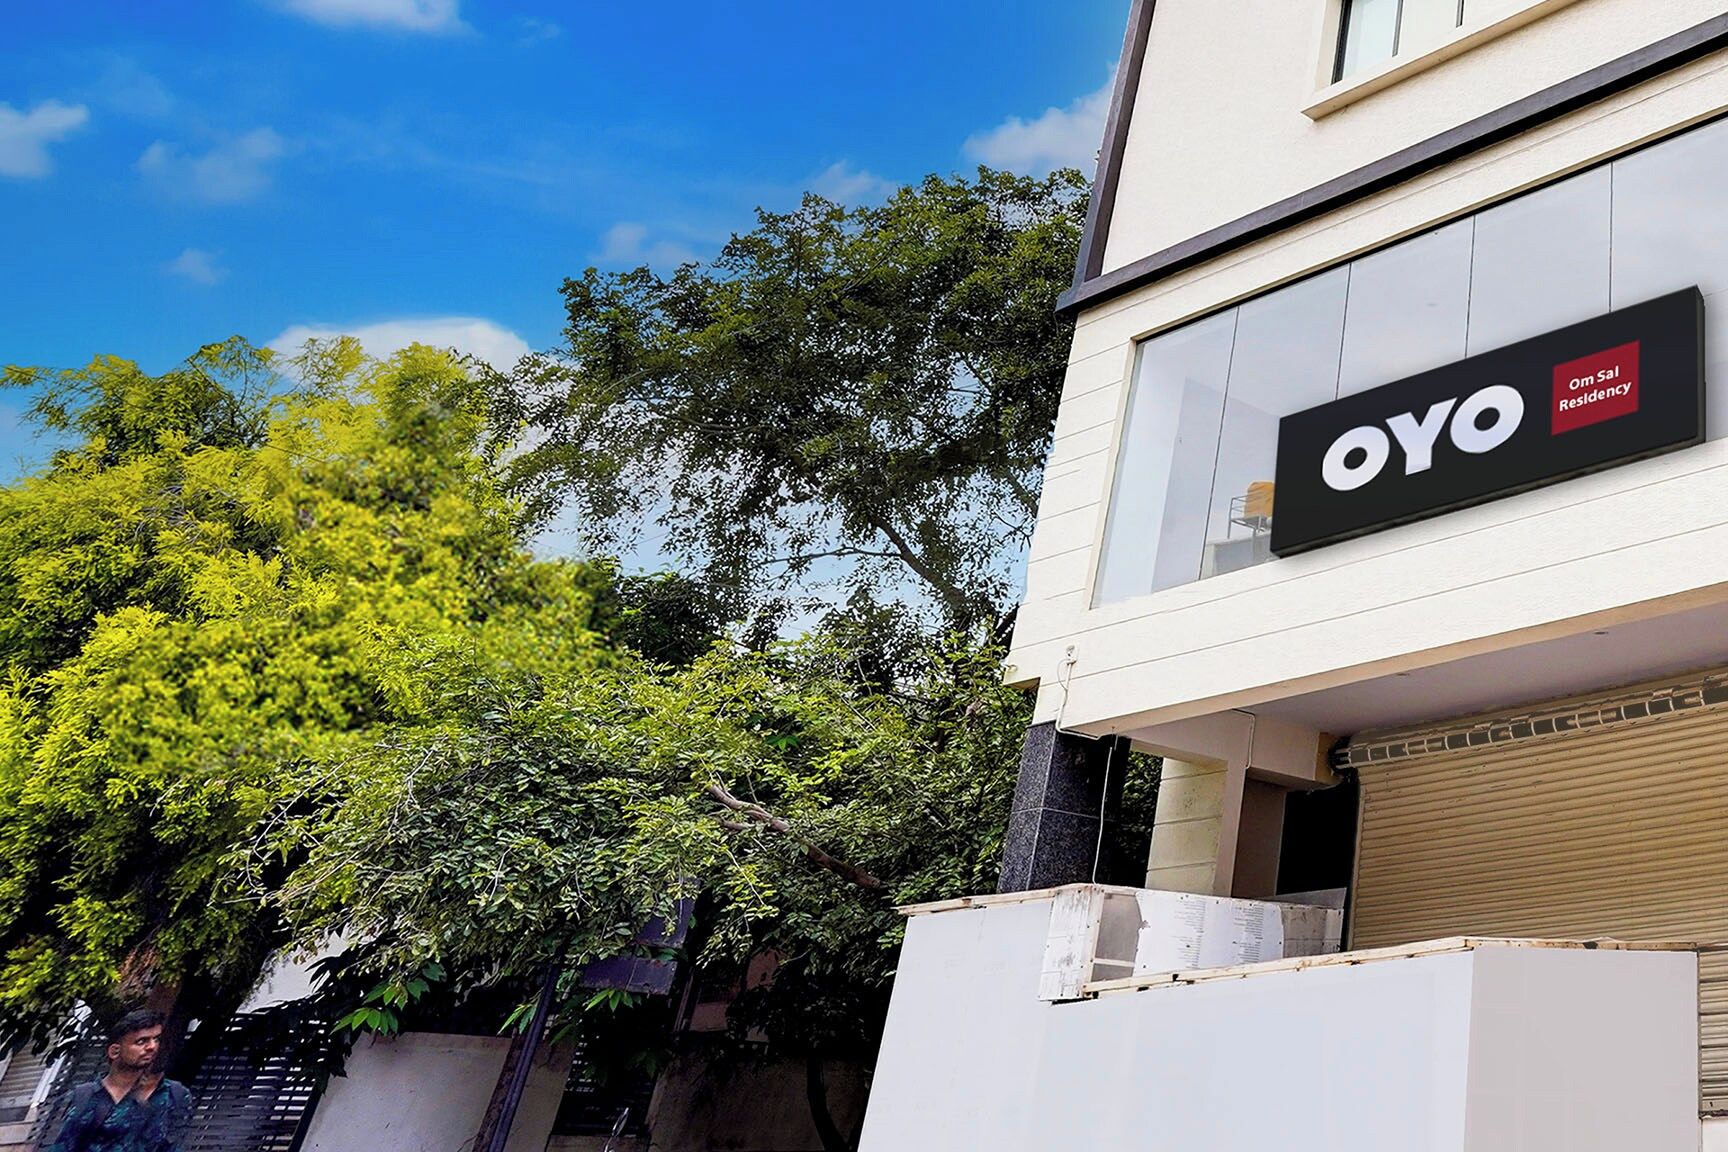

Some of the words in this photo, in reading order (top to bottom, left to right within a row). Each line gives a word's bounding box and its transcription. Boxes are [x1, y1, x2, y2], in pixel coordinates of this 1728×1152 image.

[1559, 380, 1632, 412] Residency
[1569, 374, 1594, 391] Om
[1321, 384, 1525, 492] OYO
